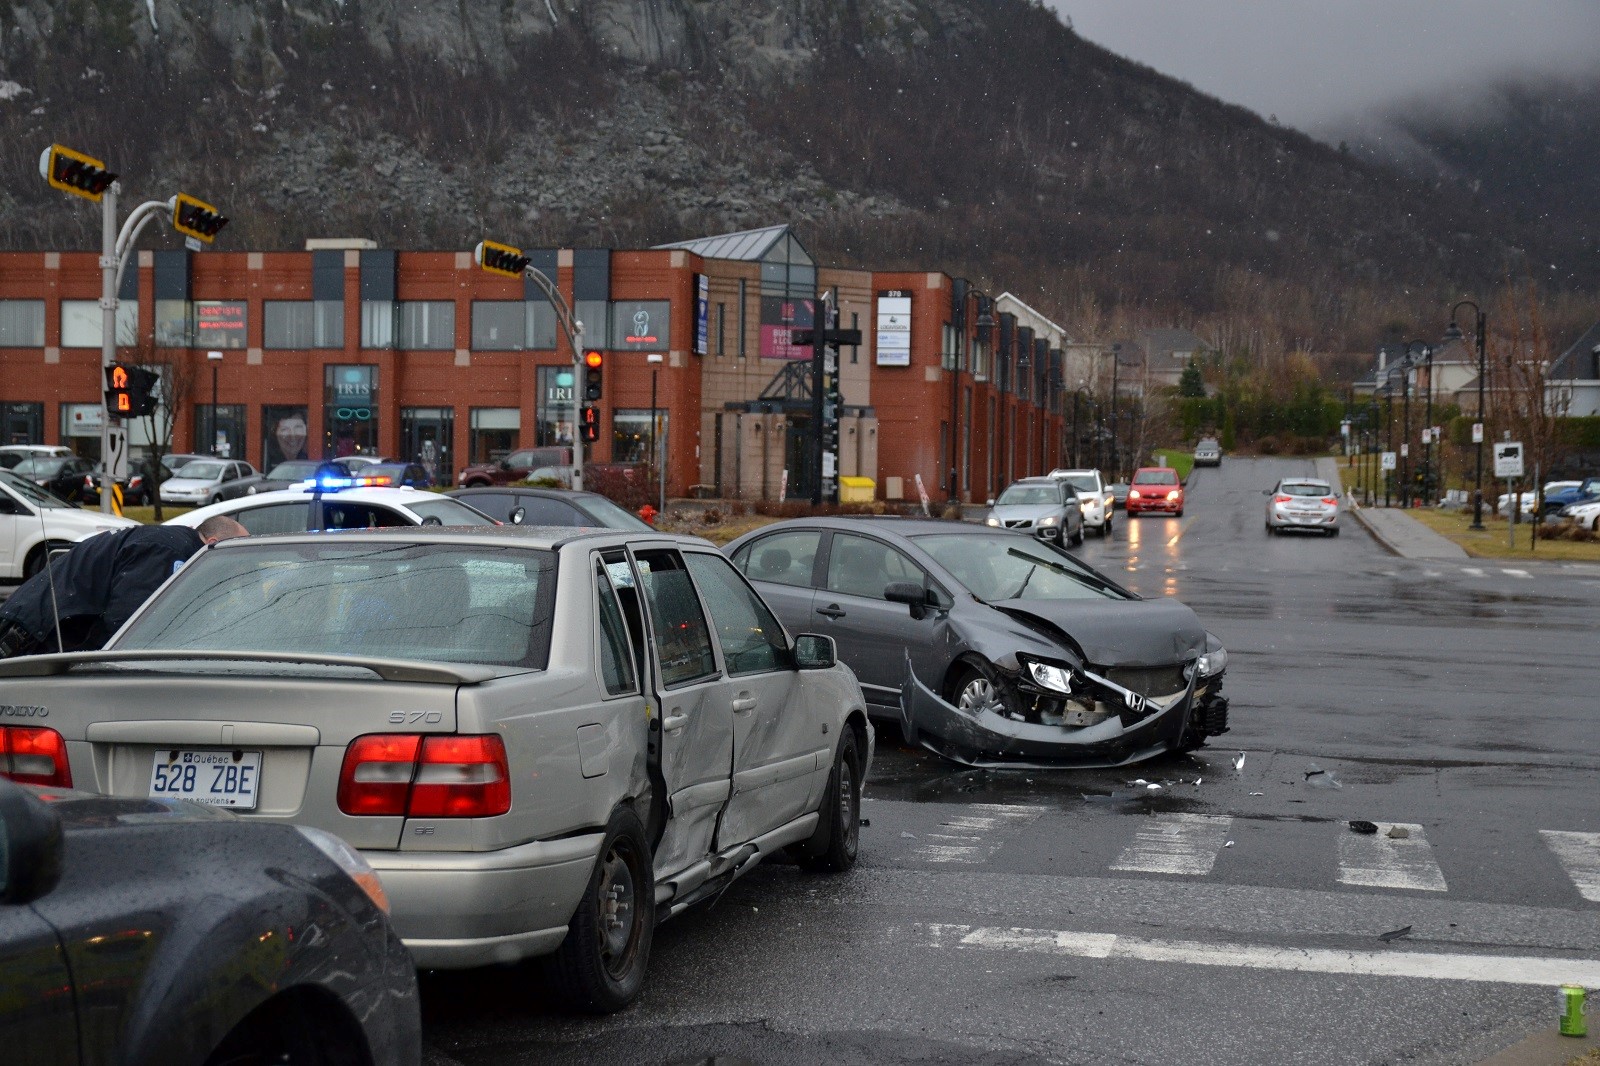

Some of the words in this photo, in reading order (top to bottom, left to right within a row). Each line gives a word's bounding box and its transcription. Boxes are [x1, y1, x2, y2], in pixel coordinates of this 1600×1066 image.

[338, 383, 370, 395] IRIS
[549, 387, 574, 399] IRI
[1383, 455, 1395, 465] 40
[193, 754, 229, 764] Québec
[154, 764, 197, 792] 528
[210, 765, 254, 794] ZBE
[196, 797, 229, 805] souviens
